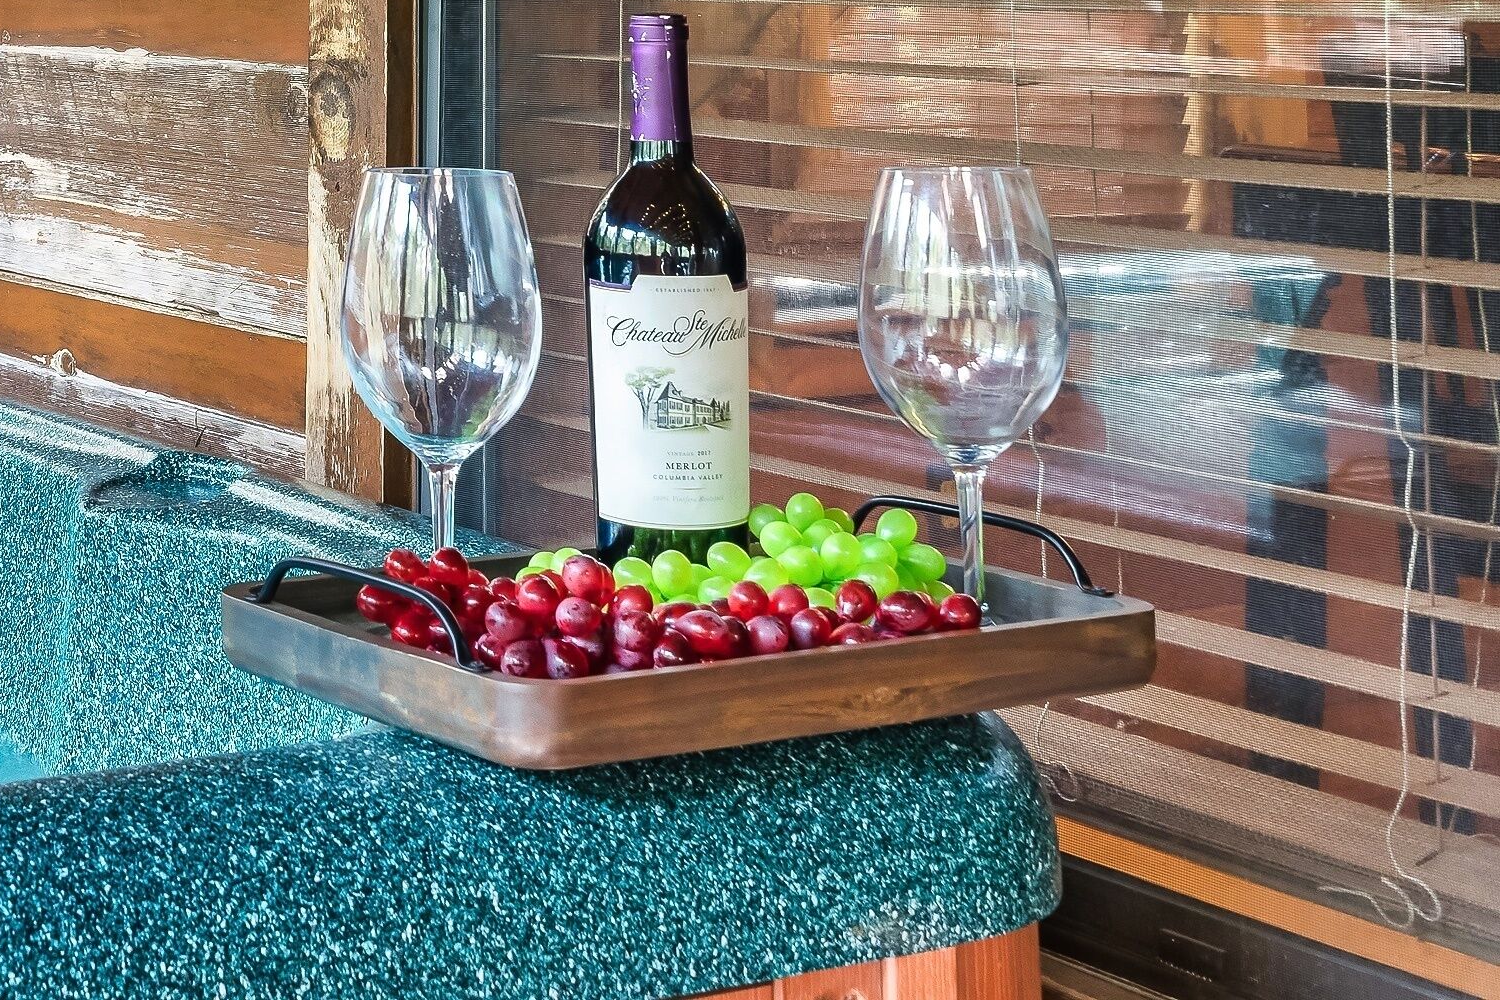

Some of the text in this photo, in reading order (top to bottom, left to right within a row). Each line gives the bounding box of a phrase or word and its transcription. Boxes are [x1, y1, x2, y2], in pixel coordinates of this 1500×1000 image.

[606, 315, 687, 347] Chateau
[673, 309, 708, 337] Ste
[665, 462, 713, 470] MERLOT
[697, 473, 723, 481] VALLEY
